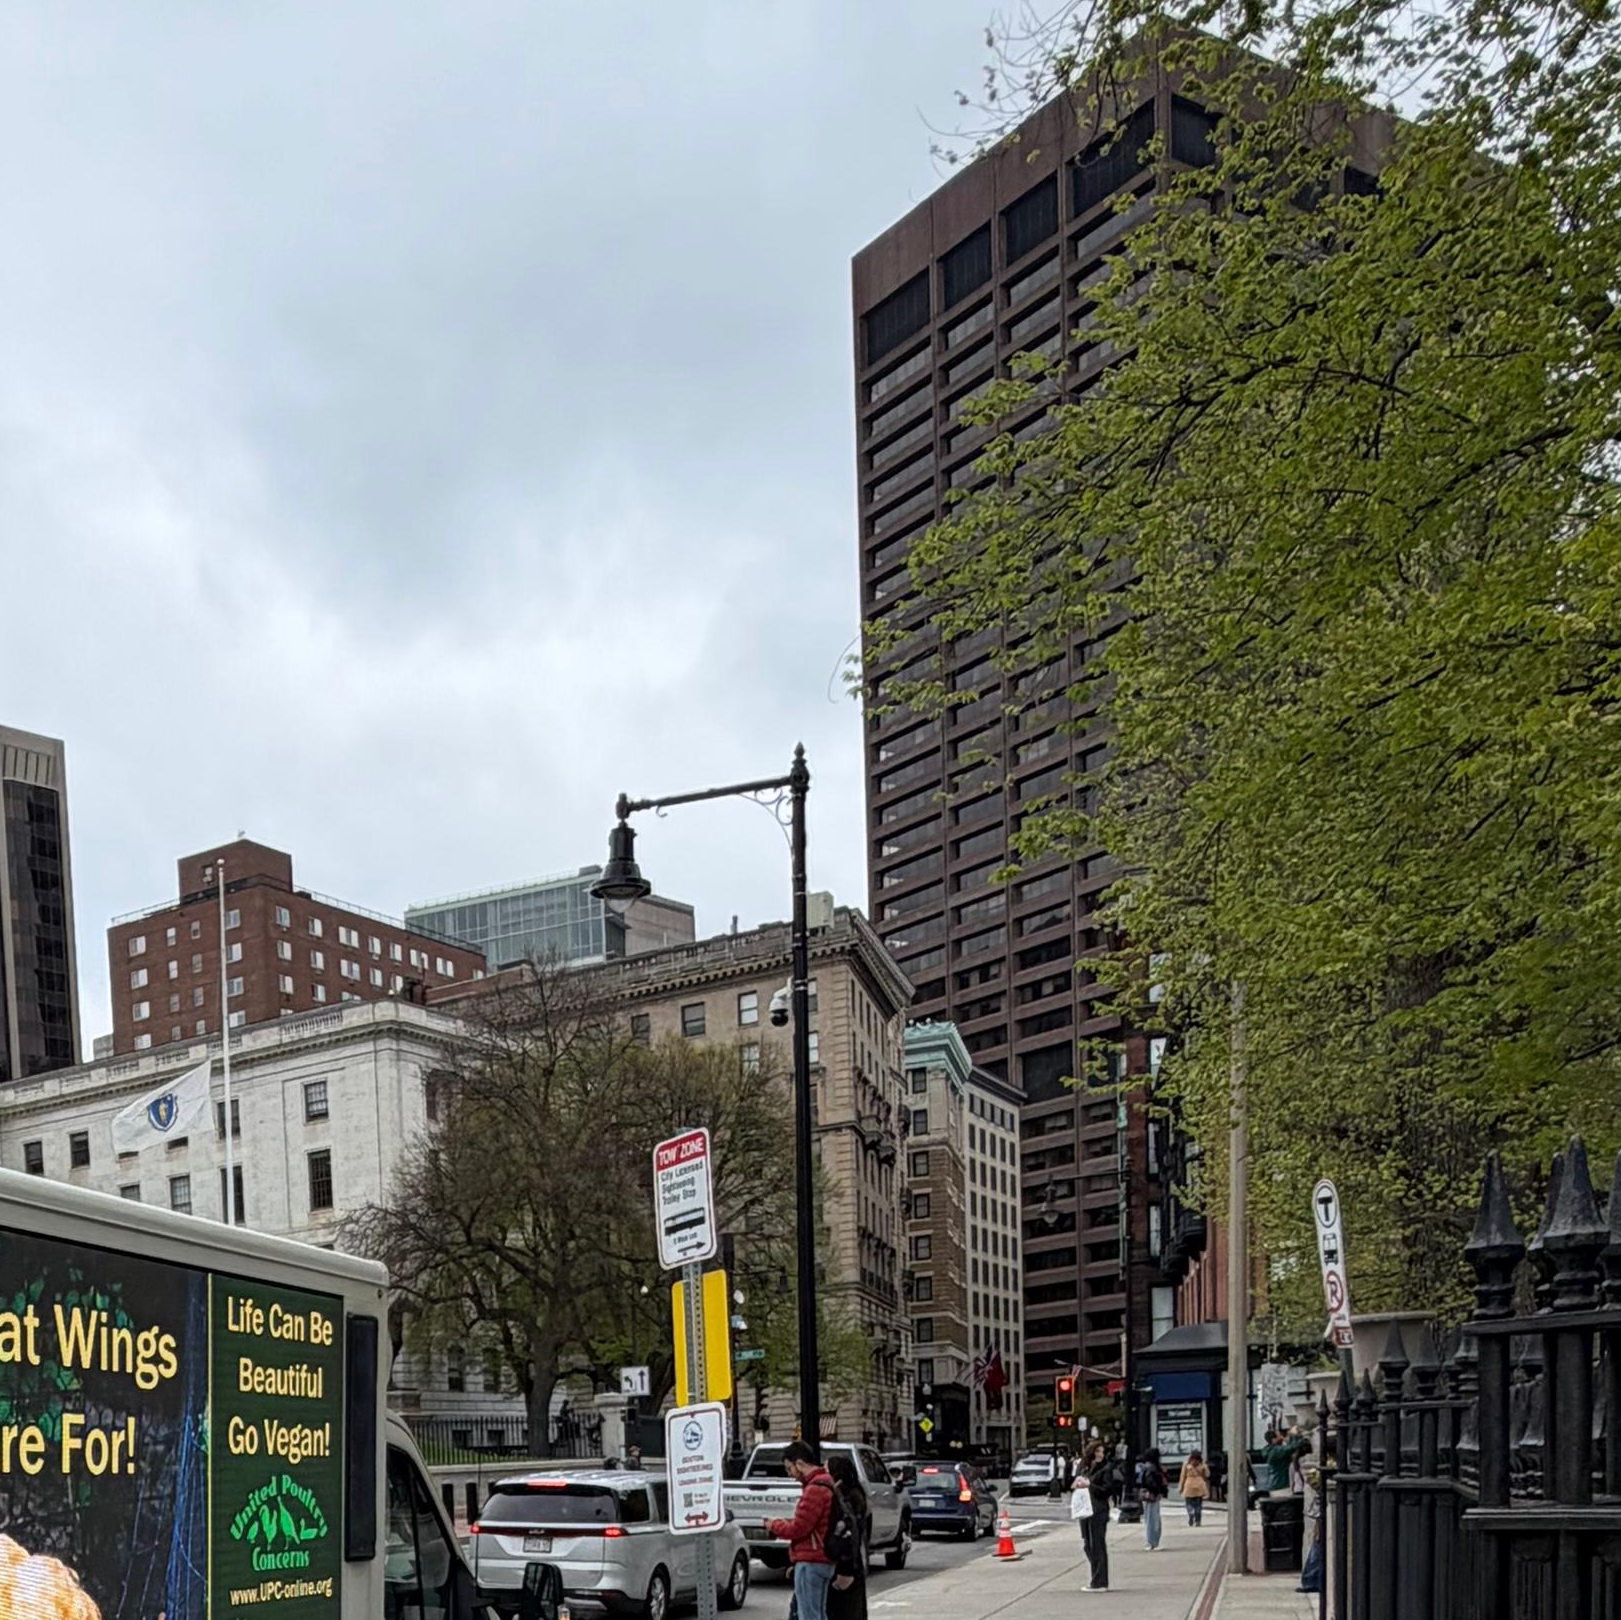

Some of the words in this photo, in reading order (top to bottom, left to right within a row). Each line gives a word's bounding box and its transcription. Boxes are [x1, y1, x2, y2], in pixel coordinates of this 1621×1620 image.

[659, 1145, 678, 1166] TOW
[680, 1136, 704, 1158] ZONE
[1318, 1196, 1333, 1222] T
[228, 1296, 265, 1336] Life
[269, 1303, 305, 1342] Can
[310, 1311, 333, 1346] Be
[53, 1304, 178, 1390] Wings
[239, 1357, 323, 1399] Beautiful
[61, 1413, 136, 1475] For!
[228, 1415, 259, 1456] Go
[263, 1418, 331, 1465] Vegan!
[230, 1475, 277, 1540] United
[282, 1474, 329, 1538] Poultry
[252, 1547, 310, 1571] Concerns
[229, 1577, 333, 1606] www.UPC-online.org
